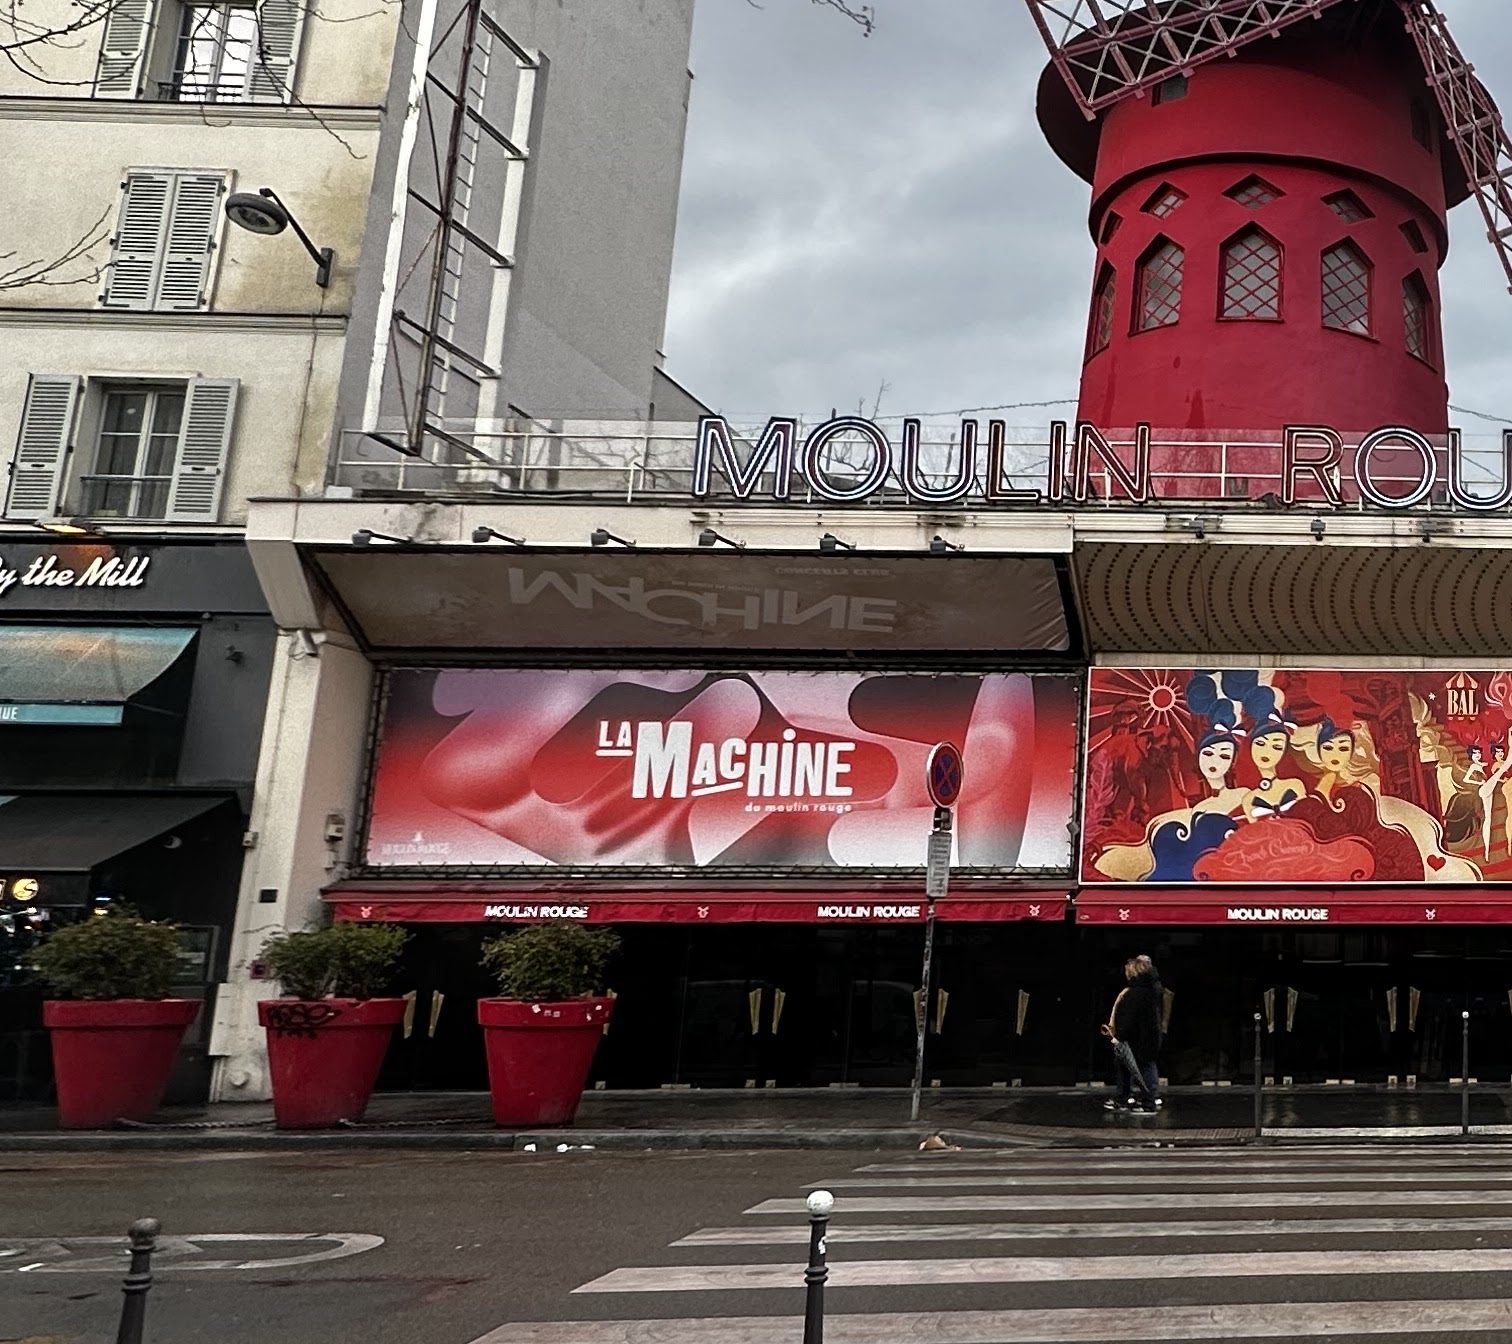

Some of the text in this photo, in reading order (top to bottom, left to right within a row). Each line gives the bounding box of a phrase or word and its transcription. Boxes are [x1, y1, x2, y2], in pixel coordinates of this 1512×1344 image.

[693, 414, 1150, 504] MOULIN
[22, 555, 75, 586] the
[75, 556, 150, 587] Mill
[1447, 689, 1479, 716] BAL
[598, 721, 632, 747] LA
[764, 801, 809, 813] moulin
[813, 803, 852, 813] rouge
[484, 905, 588, 919] MOULIN ROUGE
[817, 906, 920, 917] MOULIN ROUGE
[1227, 908, 1329, 920] MOULIN ROUGE
